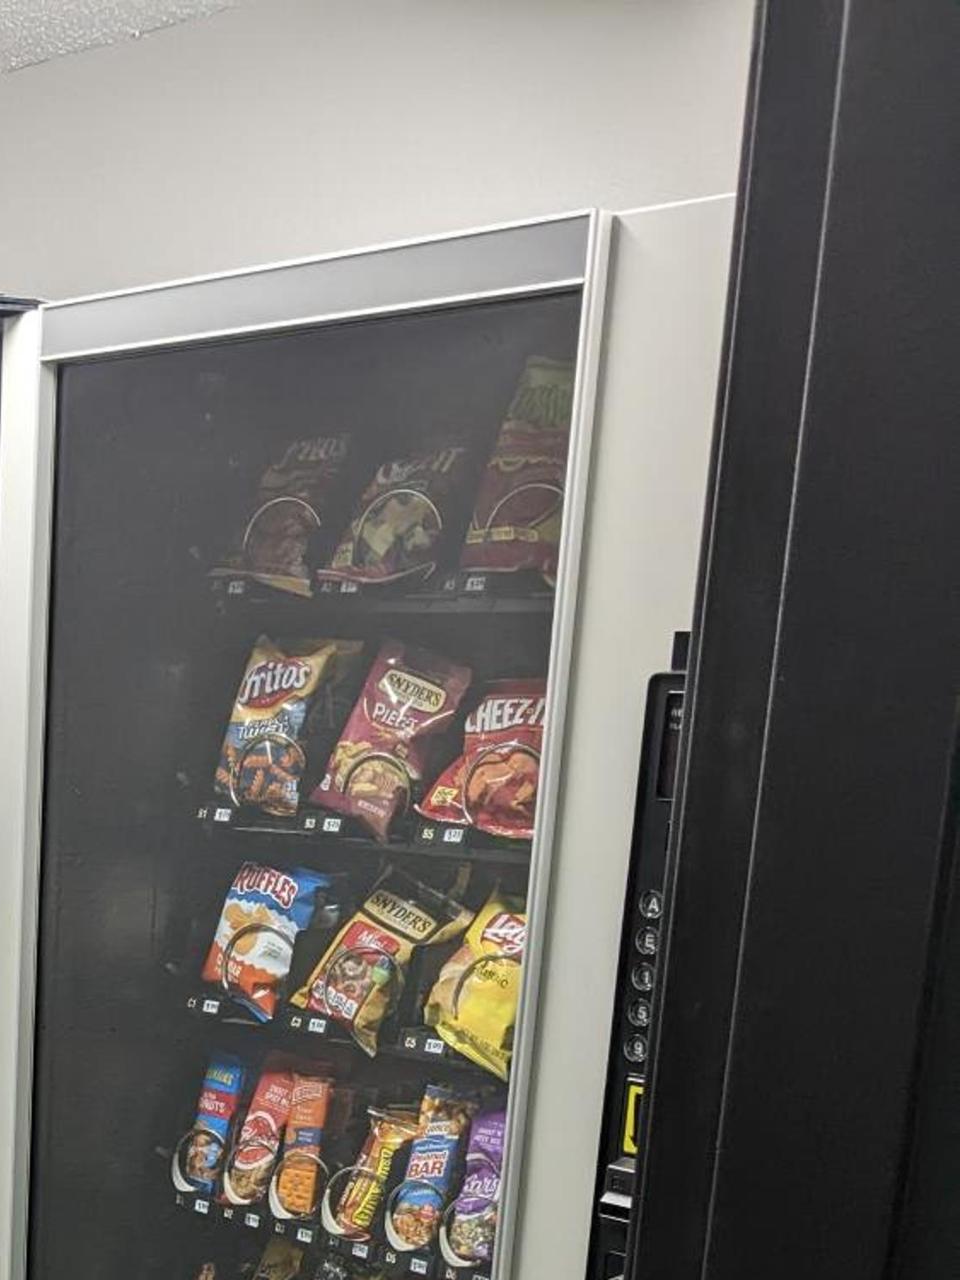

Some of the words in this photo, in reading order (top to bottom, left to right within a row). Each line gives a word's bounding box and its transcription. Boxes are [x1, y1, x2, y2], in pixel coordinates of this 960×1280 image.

[465, 697, 547, 733] CHEEZ-I
[232, 861, 299, 909] RUFFLES
[370, 893, 433, 933] SNYDER'S
[408, 1160, 444, 1179] BAR
